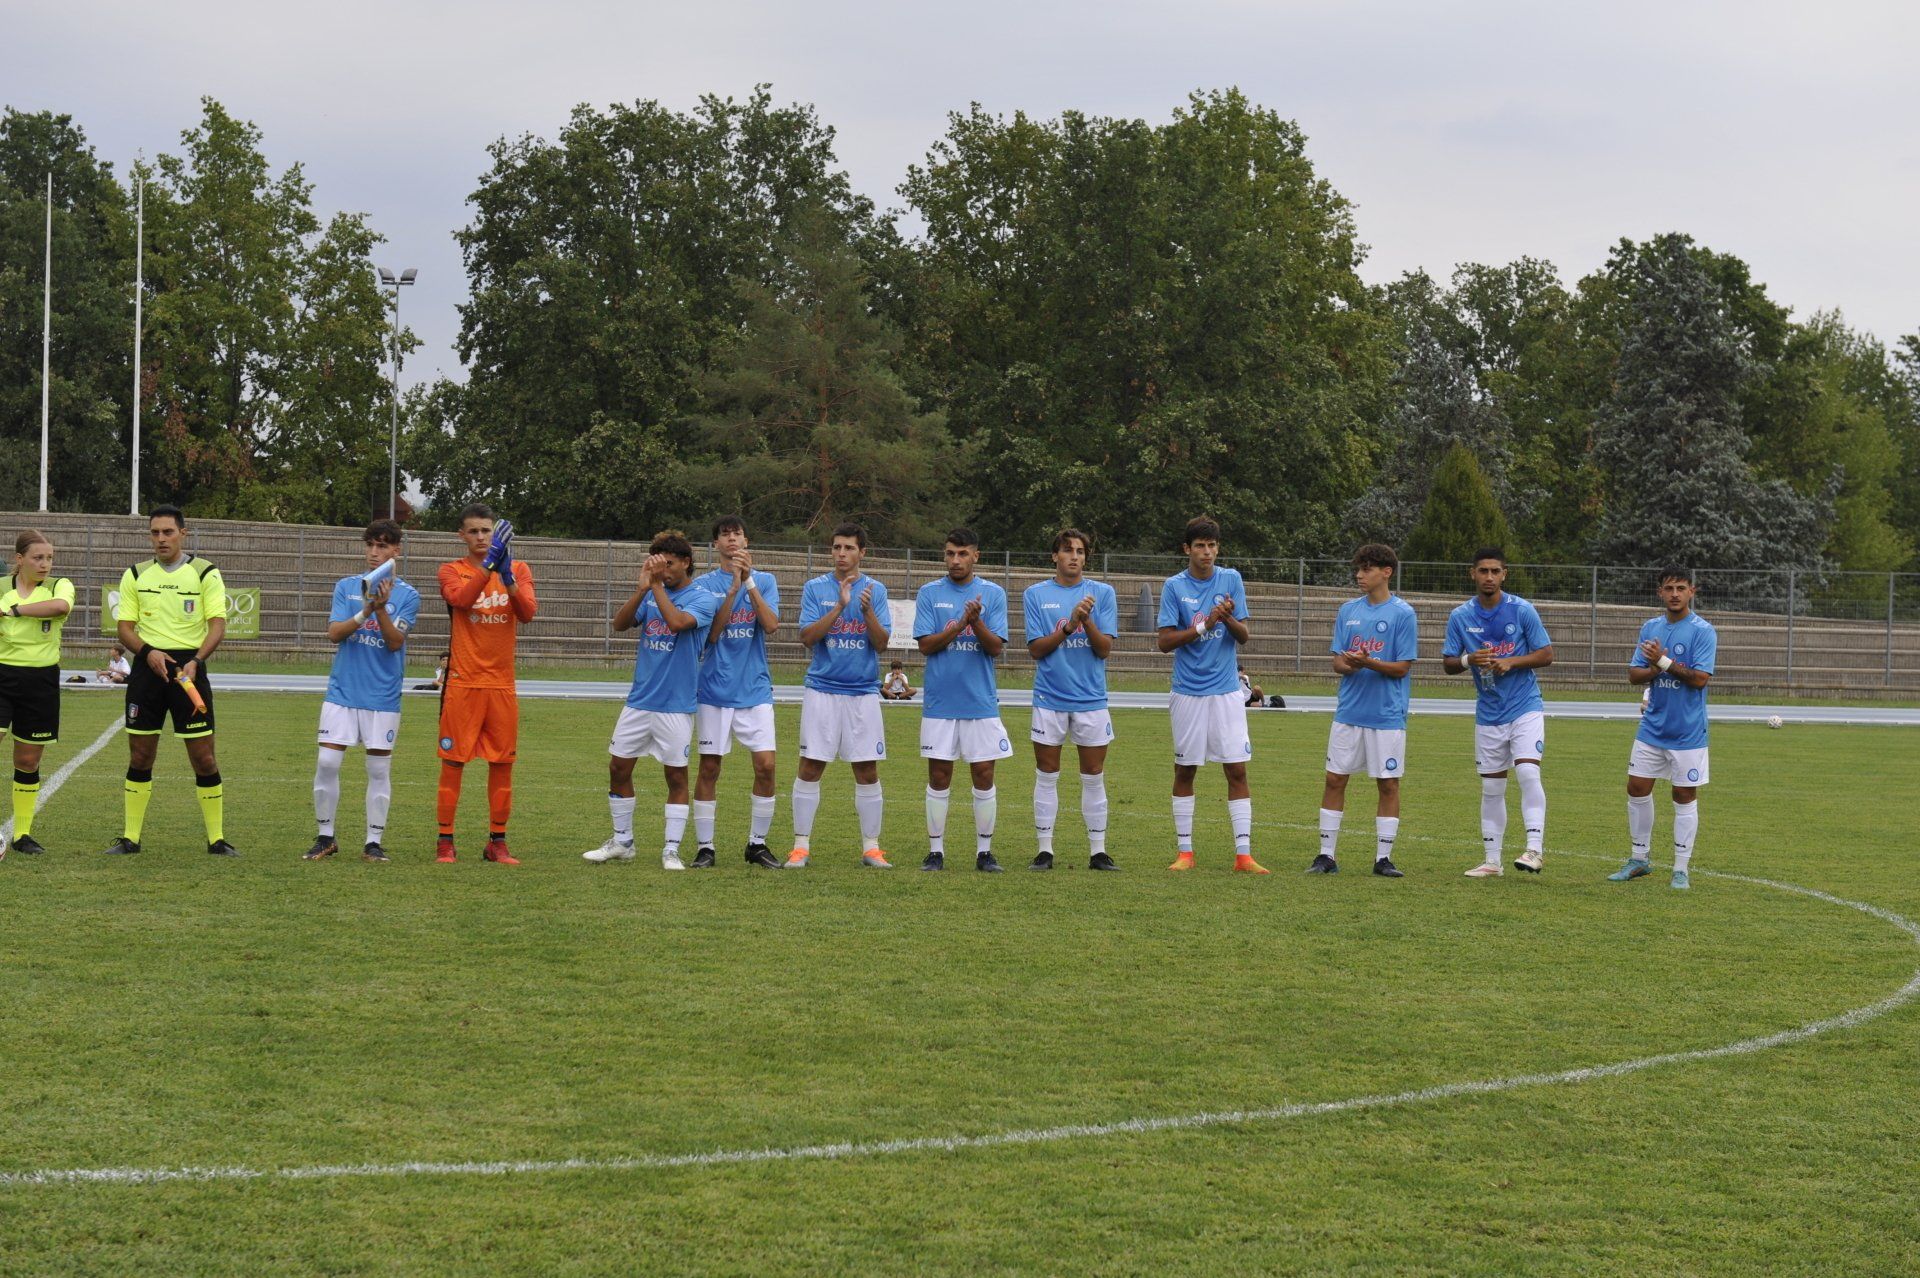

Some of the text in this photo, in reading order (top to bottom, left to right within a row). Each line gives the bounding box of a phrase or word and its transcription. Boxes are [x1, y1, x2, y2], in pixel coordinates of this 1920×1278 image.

[481, 613, 508, 624] MSC
[828, 615, 867, 634] Lete
[727, 628, 755, 639] MSC
[1200, 629, 1223, 642] MSC
[358, 633, 385, 648] MSC
[650, 640, 674, 651] MSC
[838, 638, 865, 650] MSC
[956, 640, 981, 651] MSC
[186, 721, 207, 729] LEGEA
